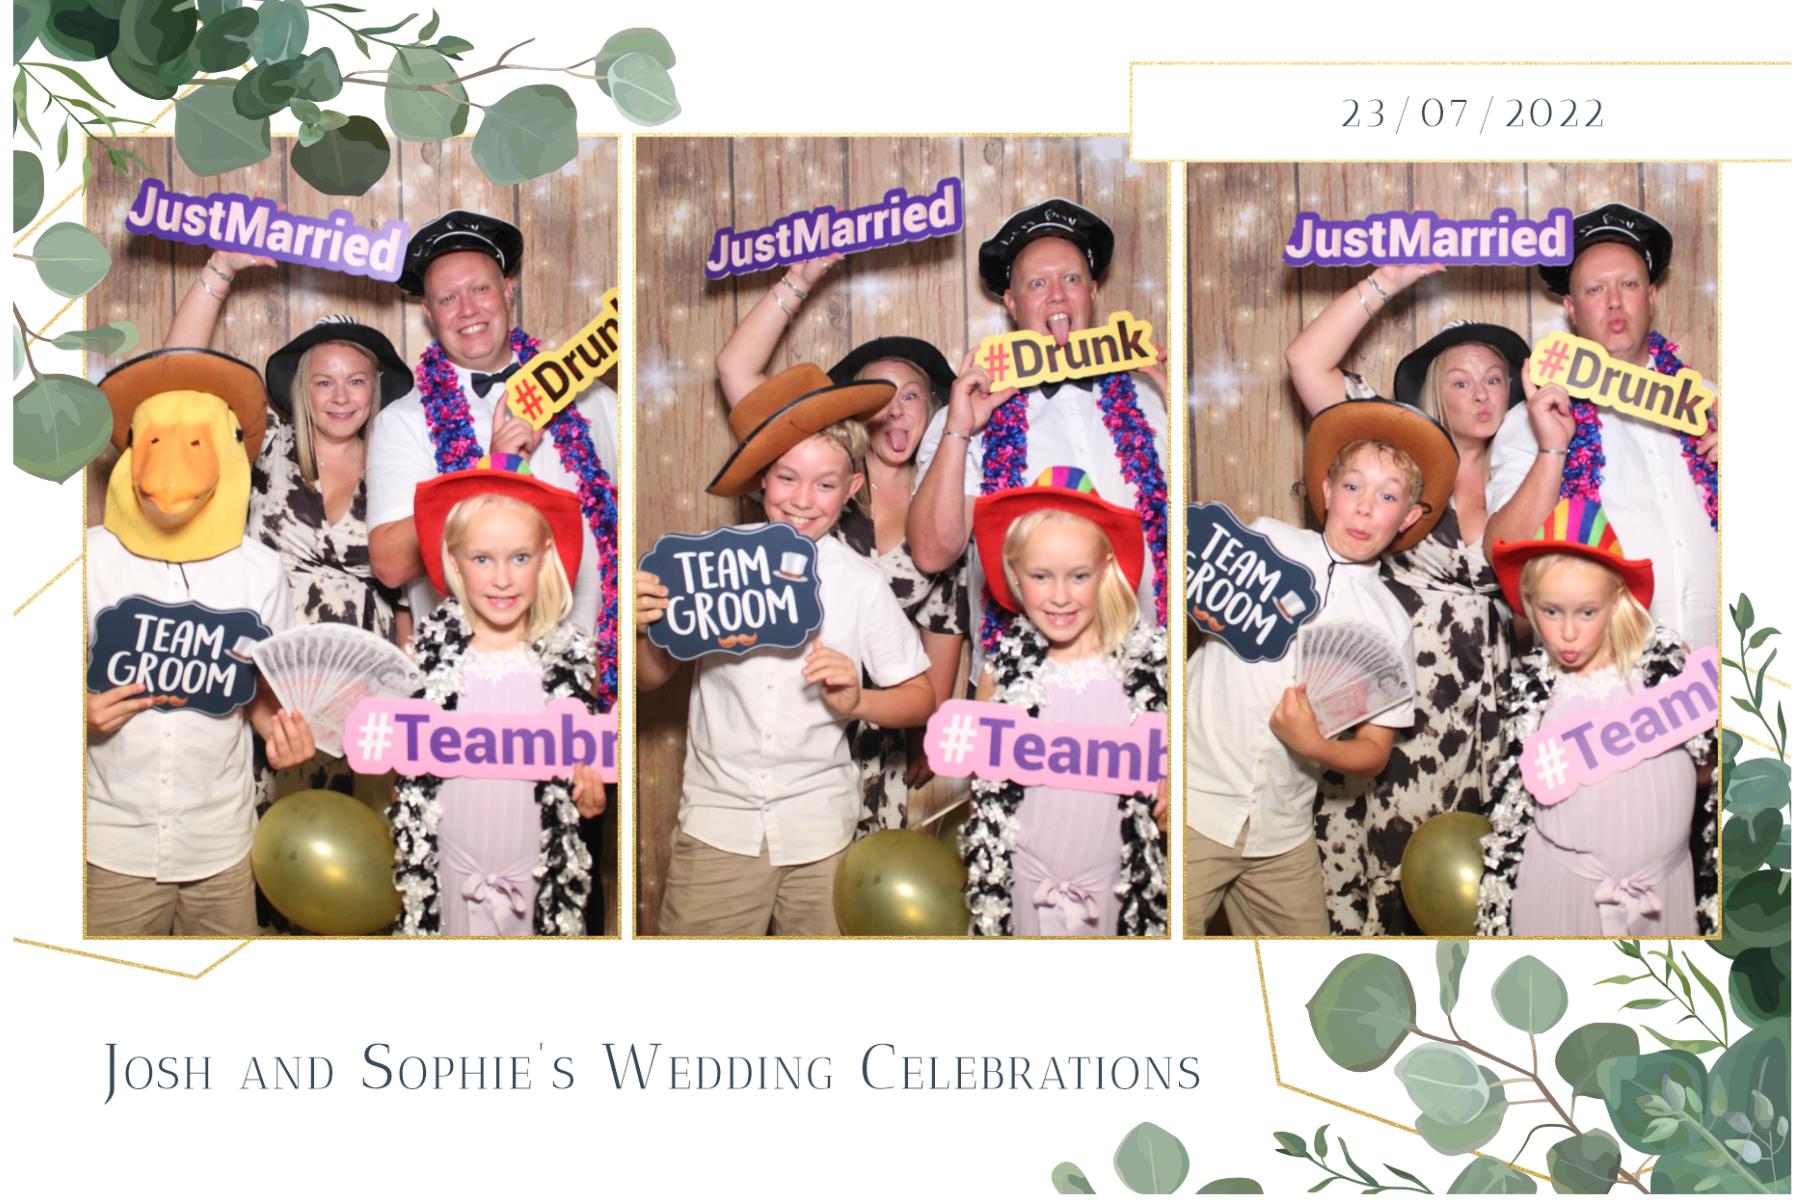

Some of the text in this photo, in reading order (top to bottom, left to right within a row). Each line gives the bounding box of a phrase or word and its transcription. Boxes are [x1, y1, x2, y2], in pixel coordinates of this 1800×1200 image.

[128, 186, 401, 273] JustMarried
[706, 186, 955, 272] JustMarried
[1285, 215, 1567, 259] JustMarried
[514, 297, 618, 421] #Drun
[983, 320, 1149, 382] #Drunk
[1537, 341, 1705, 424] #Drunk
[673, 545, 772, 592] TEAM
[1201, 522, 1281, 602] TEAM
[134, 614, 225, 660] TEAM
[666, 585, 799, 641] GROOM
[106, 651, 236, 697] GROOM
